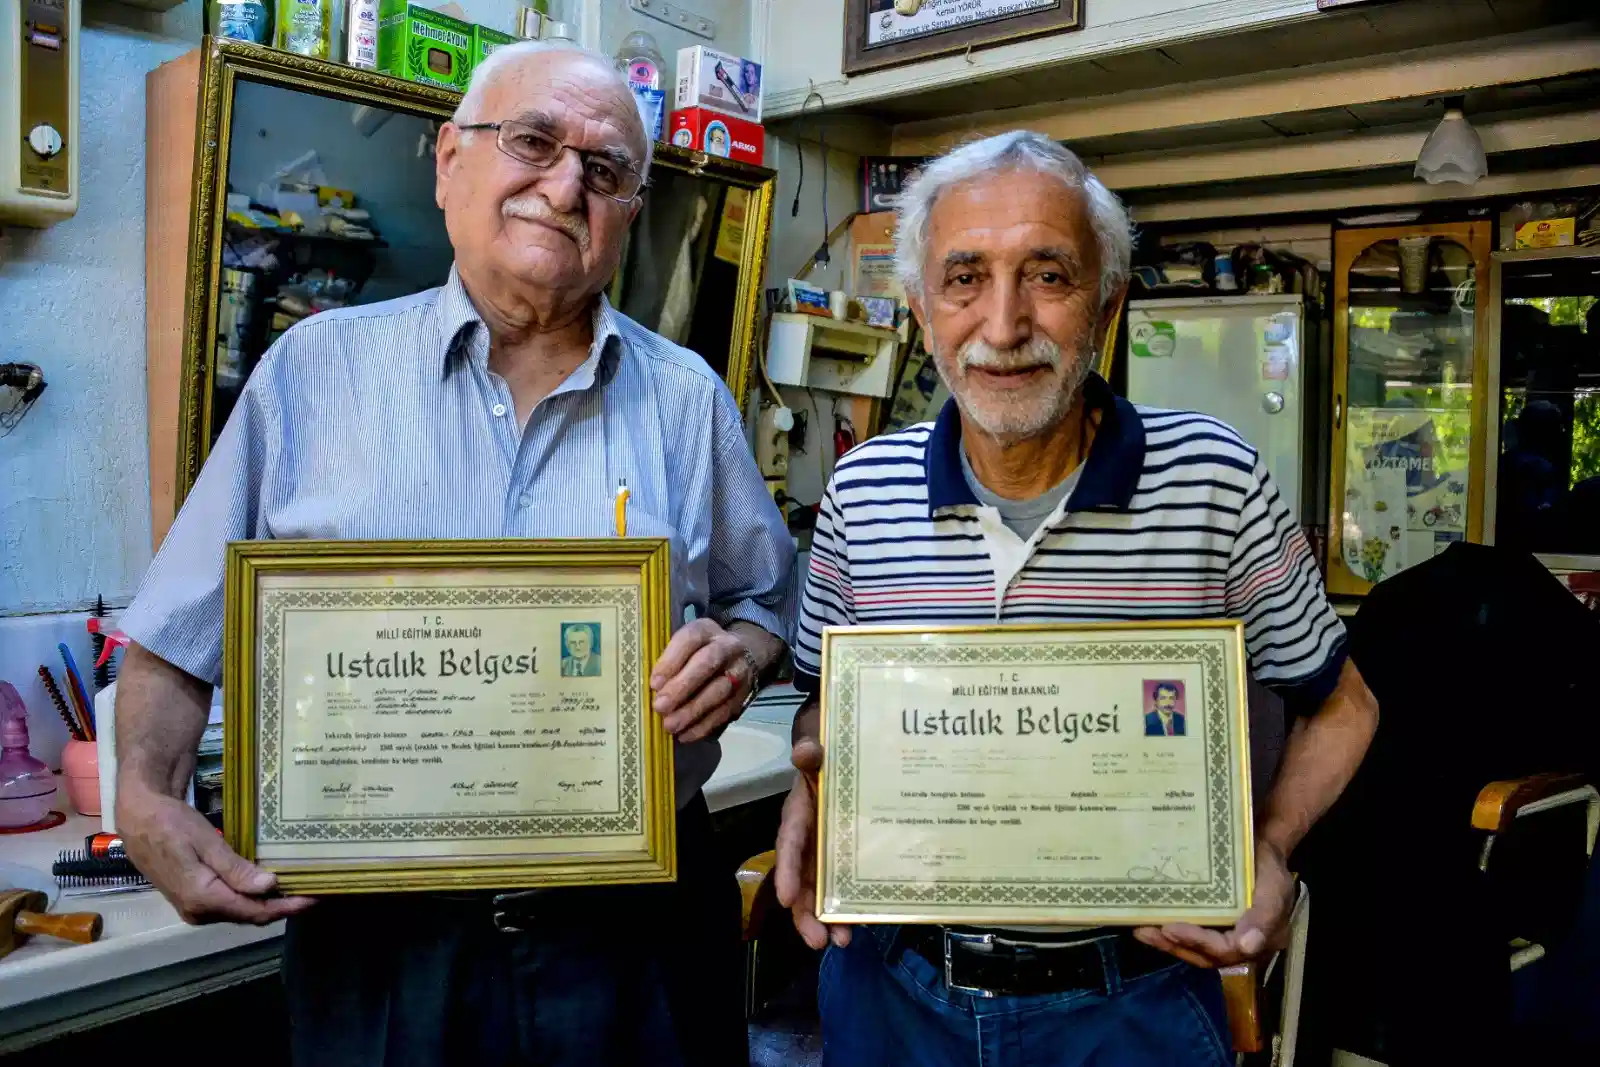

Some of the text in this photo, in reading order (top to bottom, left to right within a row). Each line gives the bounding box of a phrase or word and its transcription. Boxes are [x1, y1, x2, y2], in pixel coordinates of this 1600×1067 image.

[412, 20, 446, 41] Mehmet
[731, 140, 757, 154] ARKO
[376, 626, 482, 640] MİLLİ EĞİTİM BAKANLIĞI
[326, 646, 539, 685] Ustalık Belgesi
[952, 684, 1060, 696] MİLLİ EĞİTİM BAKANLIĞI
[901, 704, 1121, 744] Ustalık Belgesi
